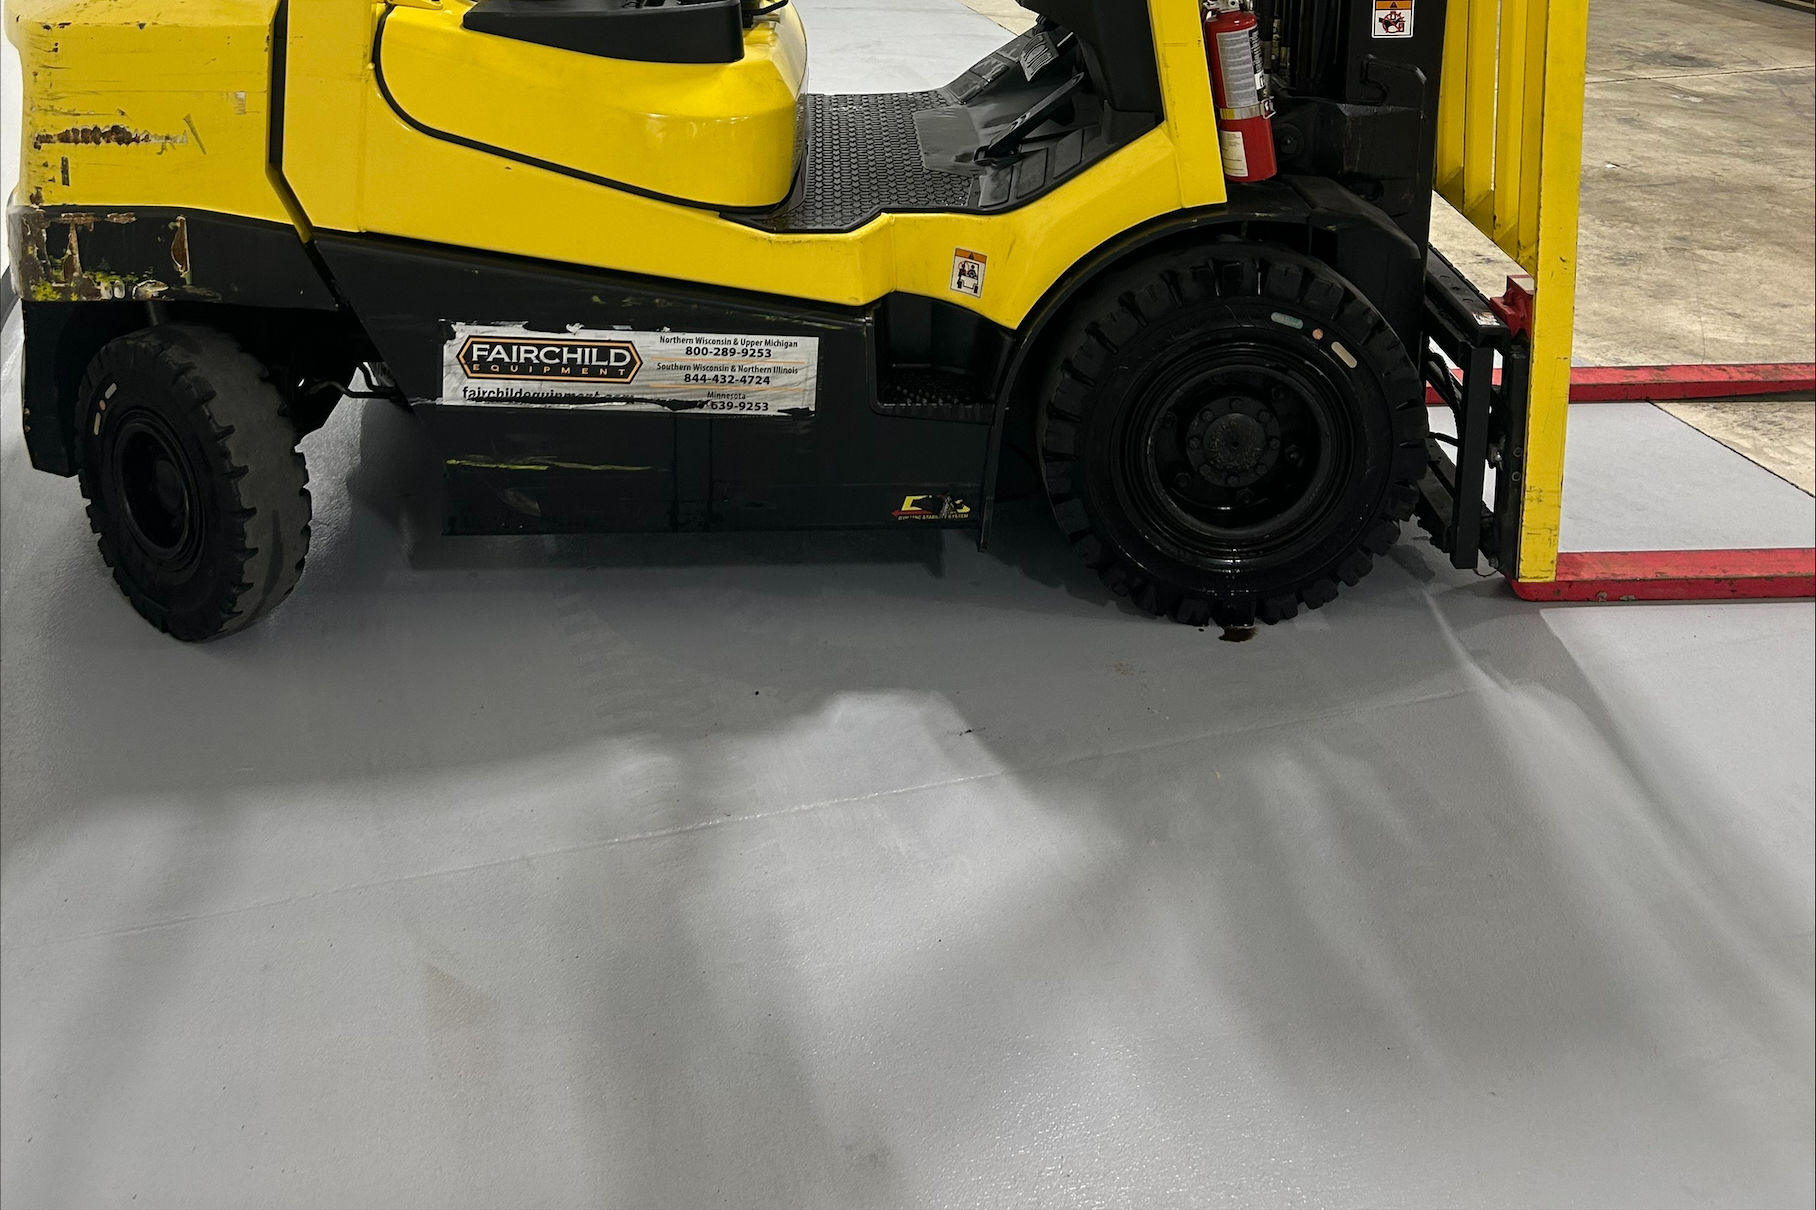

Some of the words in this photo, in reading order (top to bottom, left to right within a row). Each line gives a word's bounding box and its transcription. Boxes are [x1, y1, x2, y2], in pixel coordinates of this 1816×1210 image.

[659, 335, 694, 344] Northern
[695, 336, 732, 345] Wisconsin
[740, 338, 763, 348] Upper
[764, 339, 798, 349] Michigan
[472, 344, 631, 366] FAIRCHILD
[685, 346, 772, 358] 800-289-9253
[472, 364, 626, 376] EQUIPMENT
[656, 362, 691, 371] Southern
[692, 363, 729, 372] Wisconsin
[738, 366, 773, 374] Northern
[773, 366, 799, 374] Illinois
[683, 373, 771, 385] 844-432-4724
[706, 391, 746, 400] Minnesota
